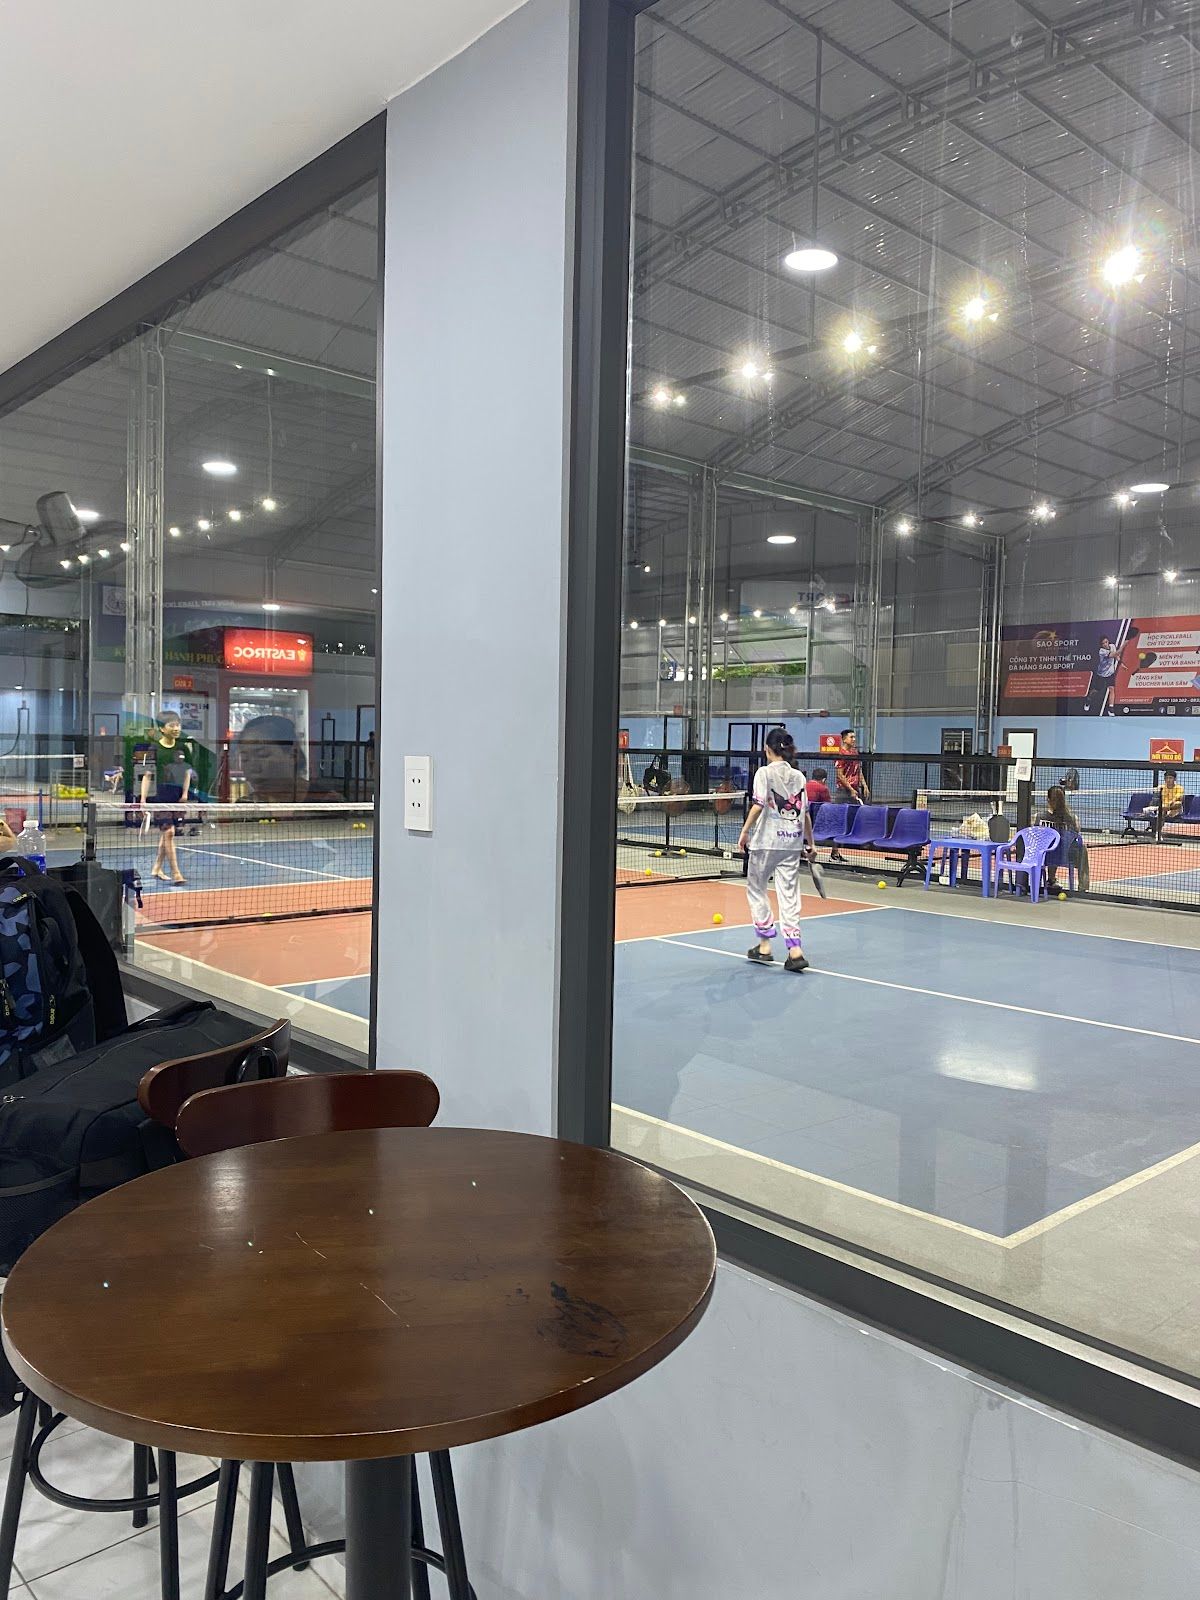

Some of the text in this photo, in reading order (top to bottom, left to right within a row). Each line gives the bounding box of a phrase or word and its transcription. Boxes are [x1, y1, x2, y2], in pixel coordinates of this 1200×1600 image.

[1036, 639, 1079, 648] SAO SPORT
[1009, 655, 1028, 663] CÔNG
[1053, 662, 1076, 670] SPORT
